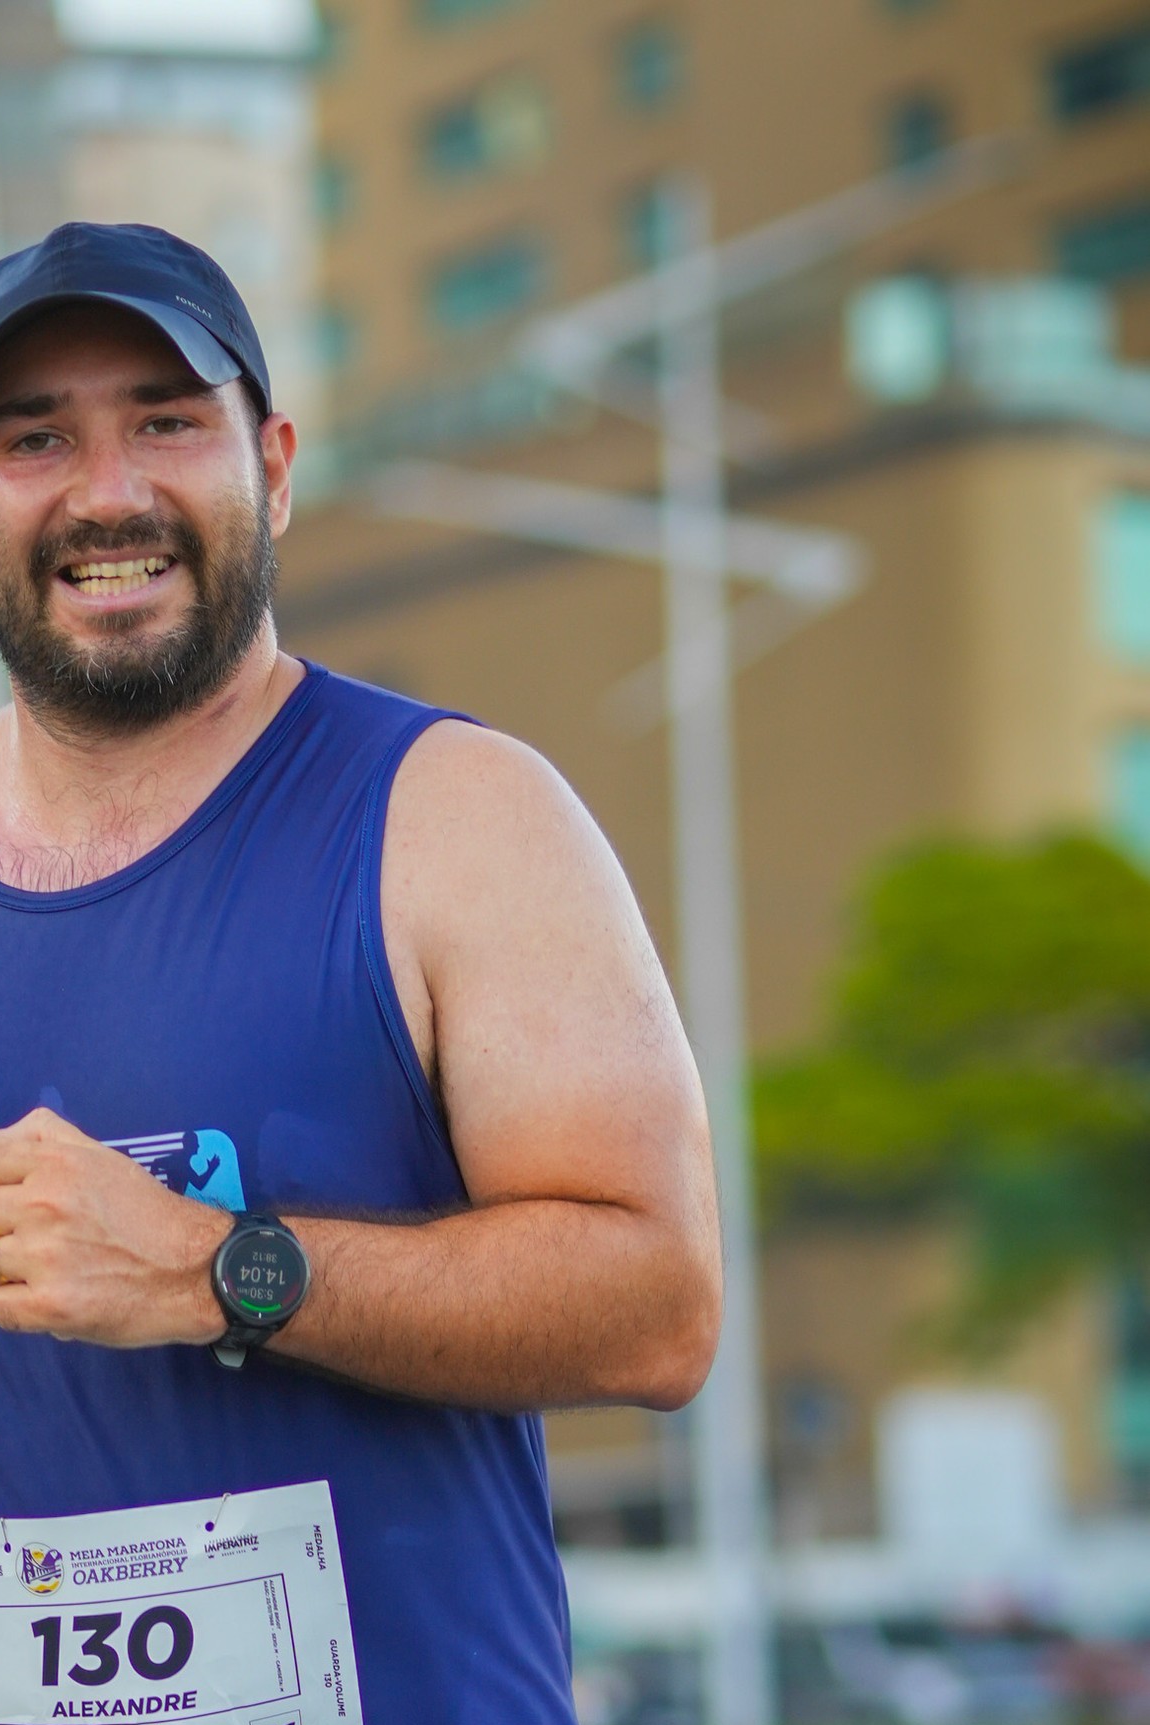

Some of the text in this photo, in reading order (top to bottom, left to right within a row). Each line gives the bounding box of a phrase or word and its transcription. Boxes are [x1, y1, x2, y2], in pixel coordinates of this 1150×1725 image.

[240, 1265, 285, 1285] 14.04
[70, 1538, 186, 1560] MEIA MARATONA
[204, 1536, 259, 1554] IMPERATRIZ
[305, 1542, 314, 1558] 130
[313, 1524, 326, 1570] MEDALHA
[72, 1548, 188, 1568] INTERNACIONAL FLORIANÓPOLIS
[72, 1556, 188, 1585] OAKBERRY
[32, 1604, 194, 1686] 130
[324, 1672, 332, 1688] 130
[330, 1638, 346, 1717] GUARDA-VOLUME
[52, 1690, 198, 1718] ALEXANDRE
